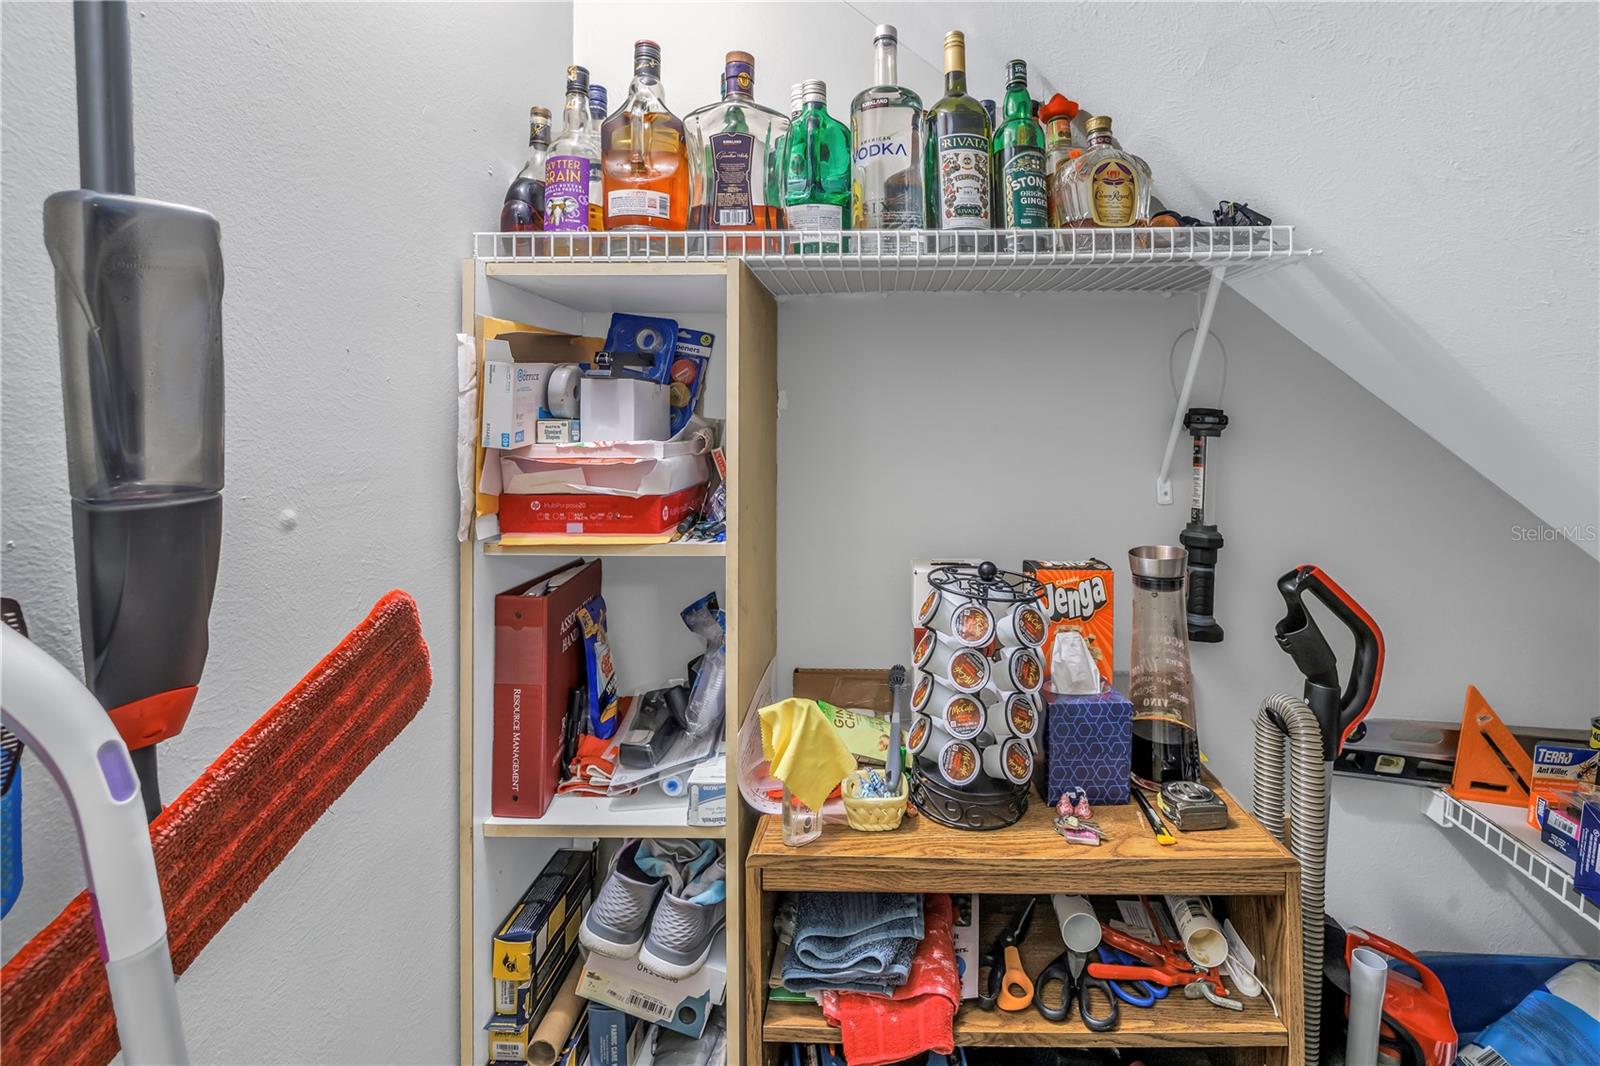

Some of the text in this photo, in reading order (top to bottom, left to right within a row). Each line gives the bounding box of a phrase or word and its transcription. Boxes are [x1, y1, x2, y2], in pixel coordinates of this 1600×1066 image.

[861, 136, 891, 145] AMERICAN
[1037, 577, 1107, 618] Jenga
[512, 689, 521, 792] RESOURCE MANAGEMENT
[1537, 766, 1549, 774] Ant
